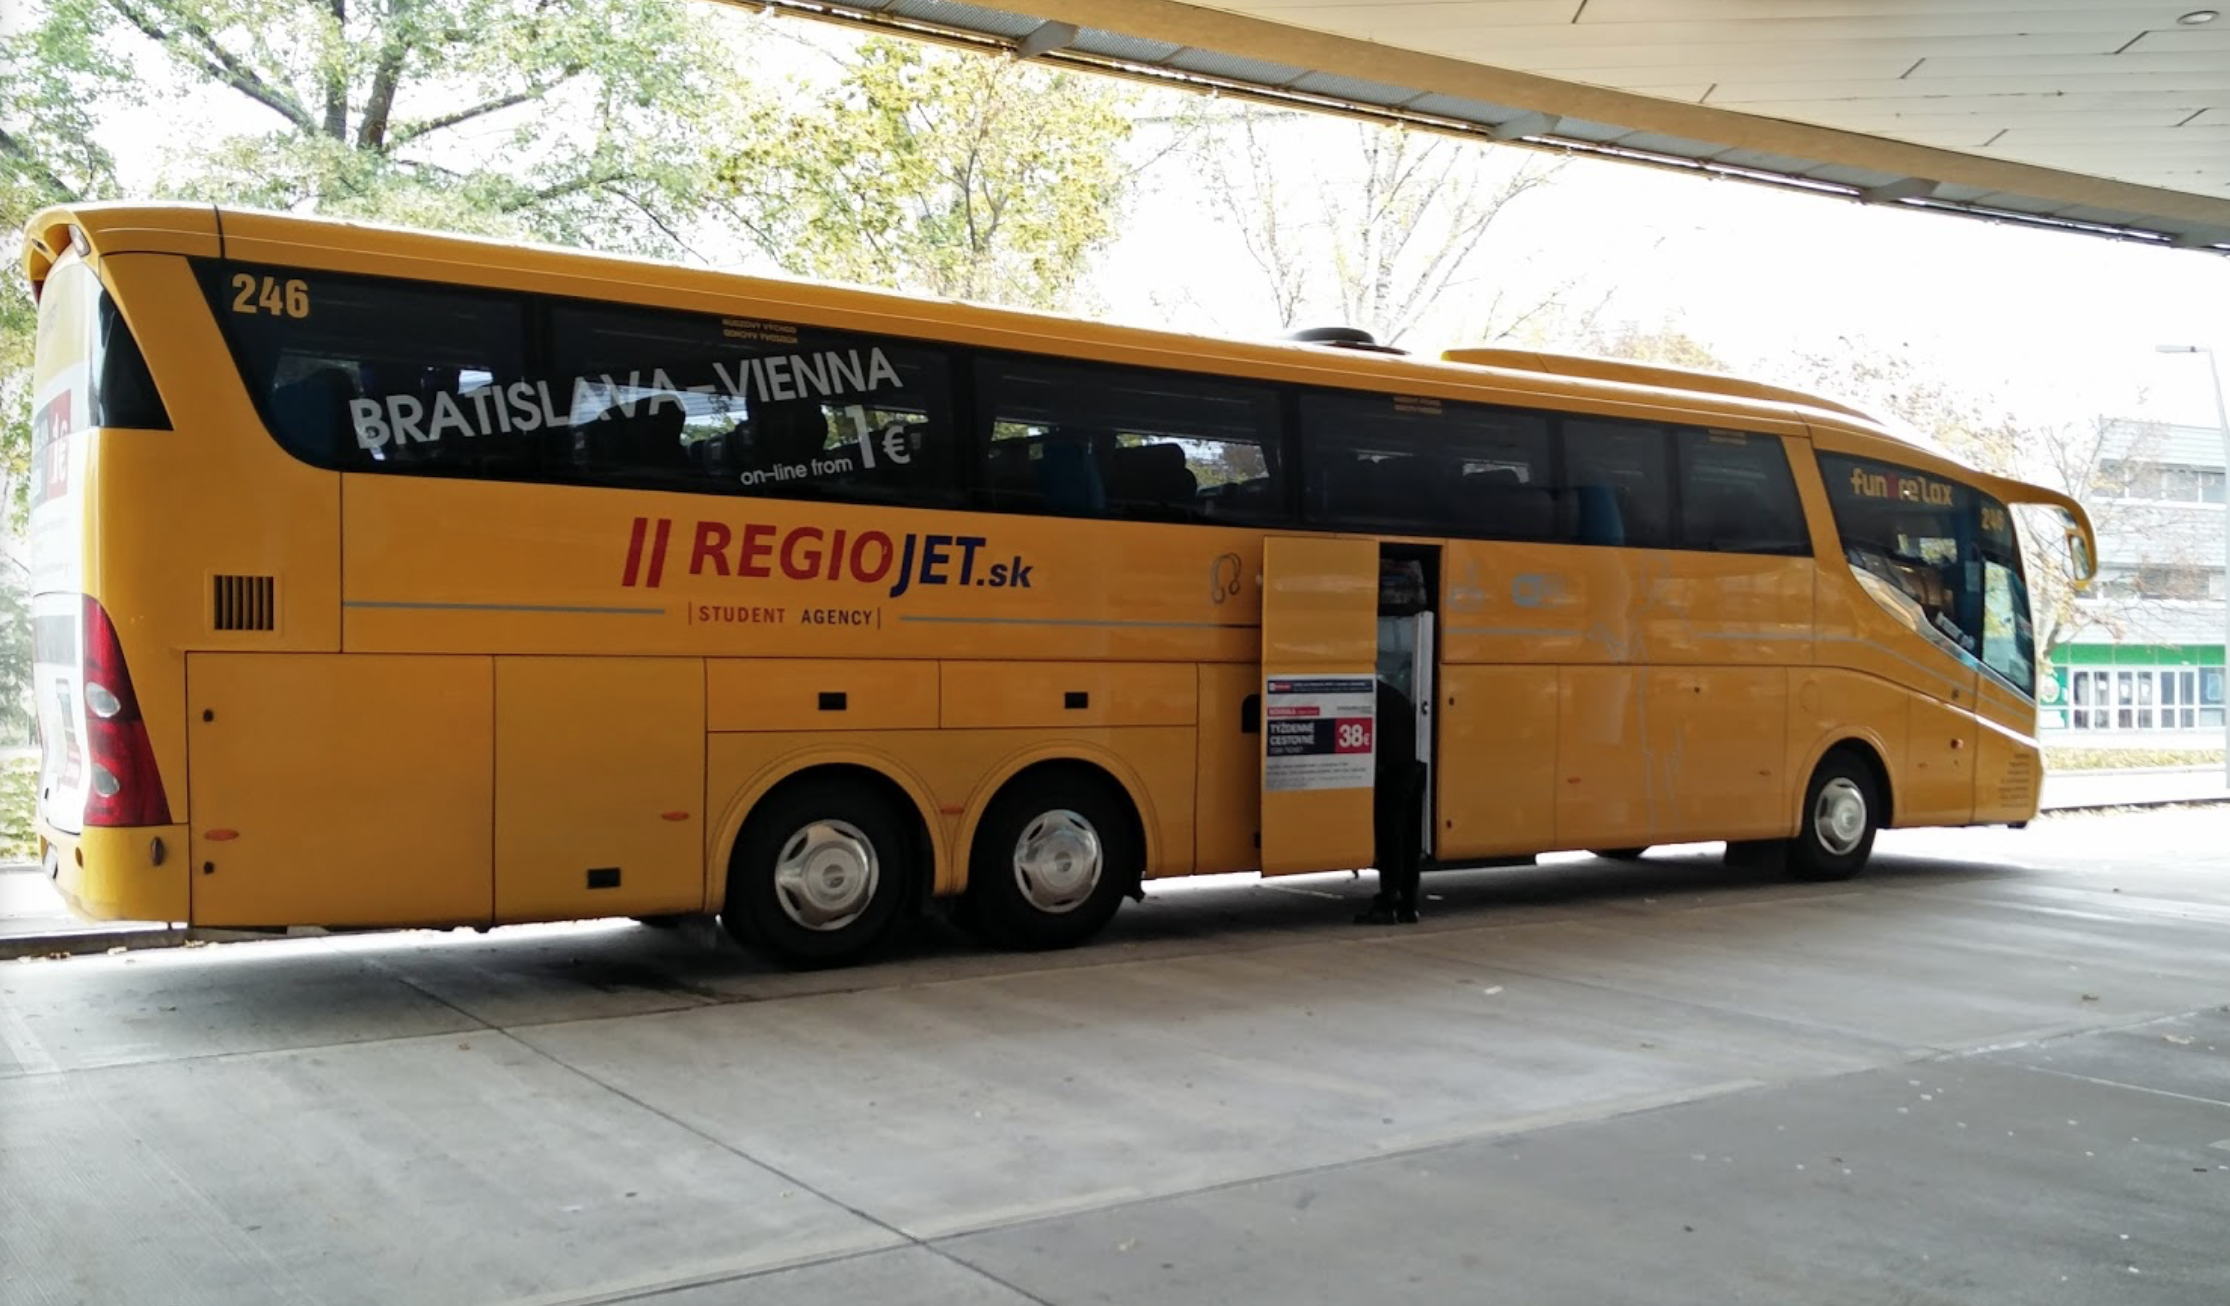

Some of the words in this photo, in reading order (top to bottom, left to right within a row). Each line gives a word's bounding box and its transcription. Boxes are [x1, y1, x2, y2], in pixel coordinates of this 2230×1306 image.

[231, 272, 310, 319] 246
[740, 463, 807, 486] on-line
[811, 457, 853, 476] from
[688, 520, 1035, 598] REGIOJET.sk
[699, 605, 786, 623] STUDENT
[800, 608, 873, 626] AGENCY
